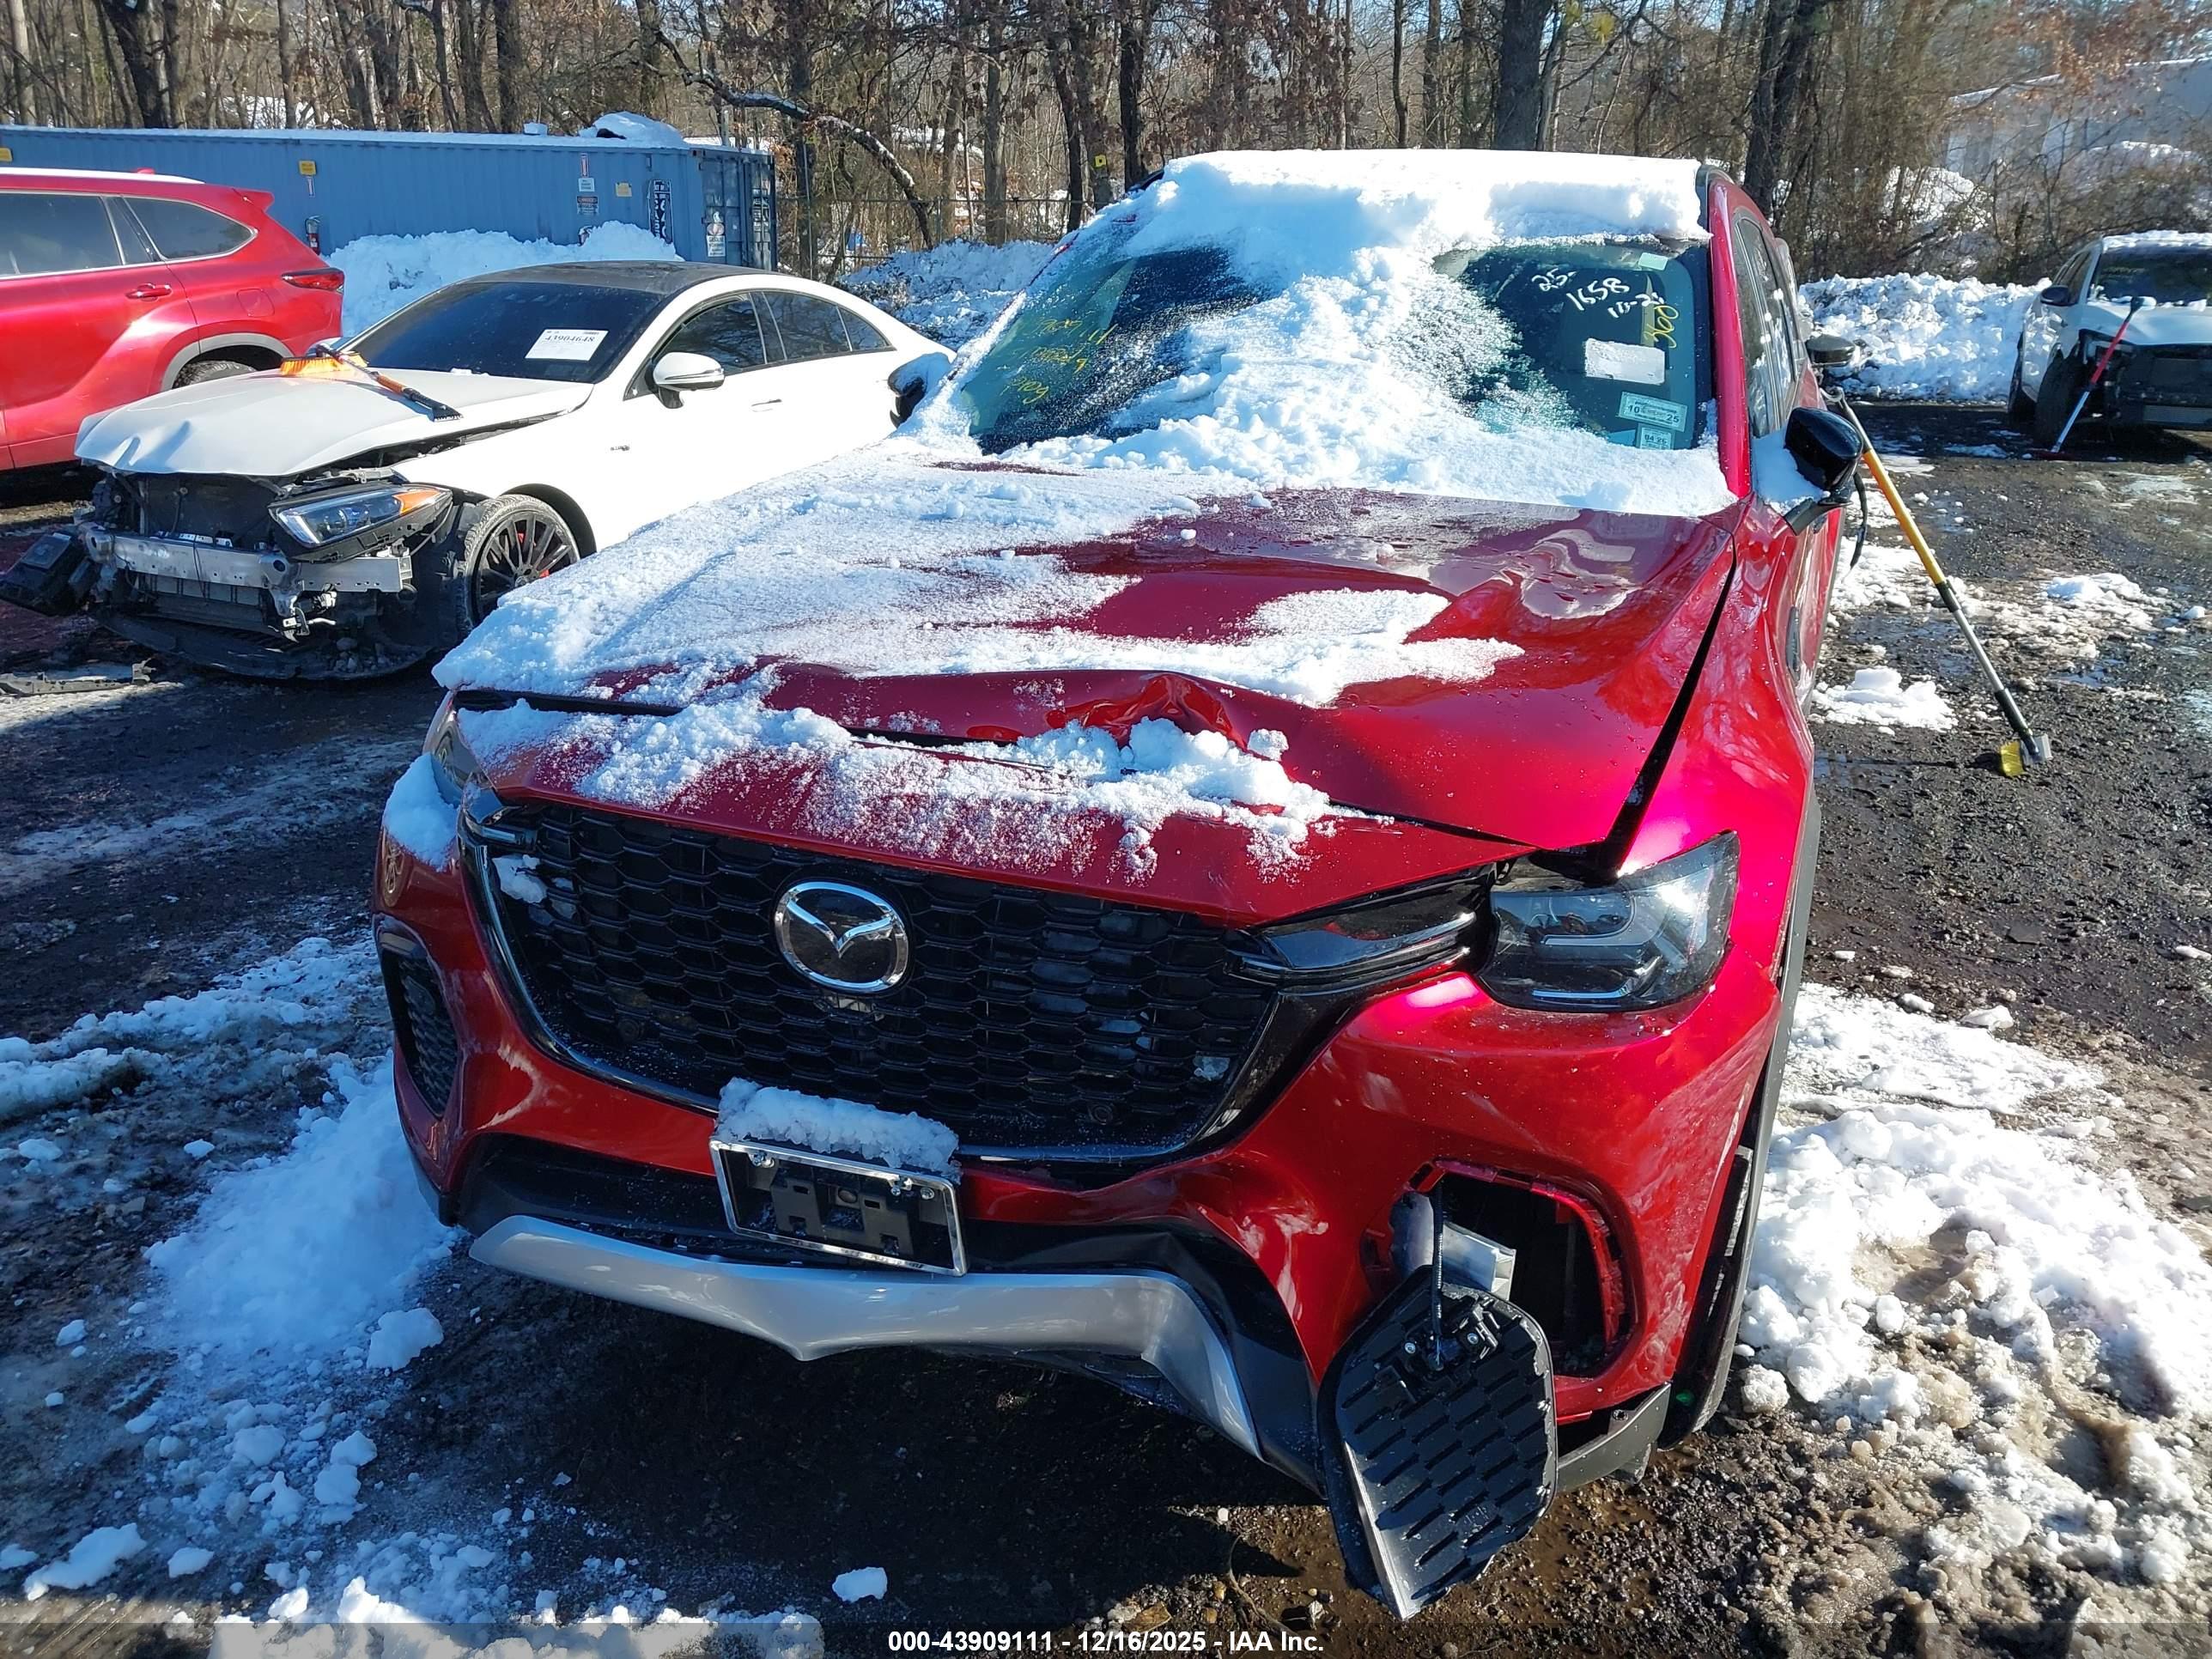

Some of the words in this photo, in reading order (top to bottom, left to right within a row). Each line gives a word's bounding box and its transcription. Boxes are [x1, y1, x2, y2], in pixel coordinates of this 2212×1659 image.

[1566, 277, 1630, 311] 1658
[1627, 404, 1640, 414] 10
[1666, 414, 1680, 423] 25
